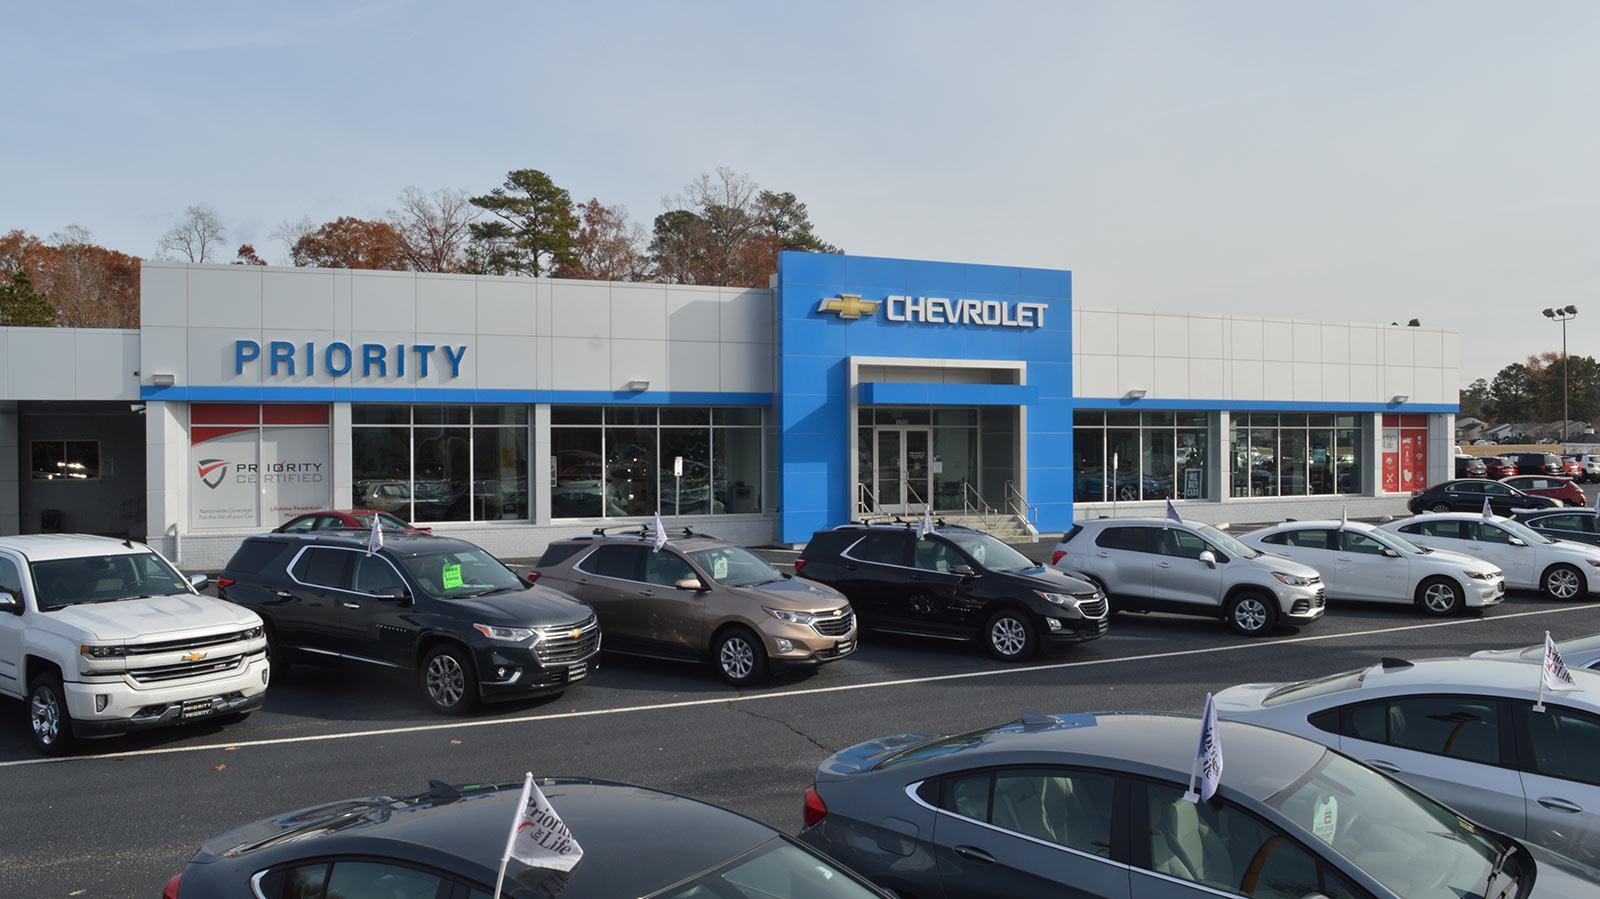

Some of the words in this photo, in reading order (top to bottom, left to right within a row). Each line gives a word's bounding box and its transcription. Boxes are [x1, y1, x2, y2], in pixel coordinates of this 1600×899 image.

[886, 295, 1049, 328] CHEVROLET
[235, 340, 468, 378] PRIORITY
[236, 462, 323, 473] PRIORITY
[236, 473, 323, 484] CERTIFIED
[539, 832, 571, 855] Life
